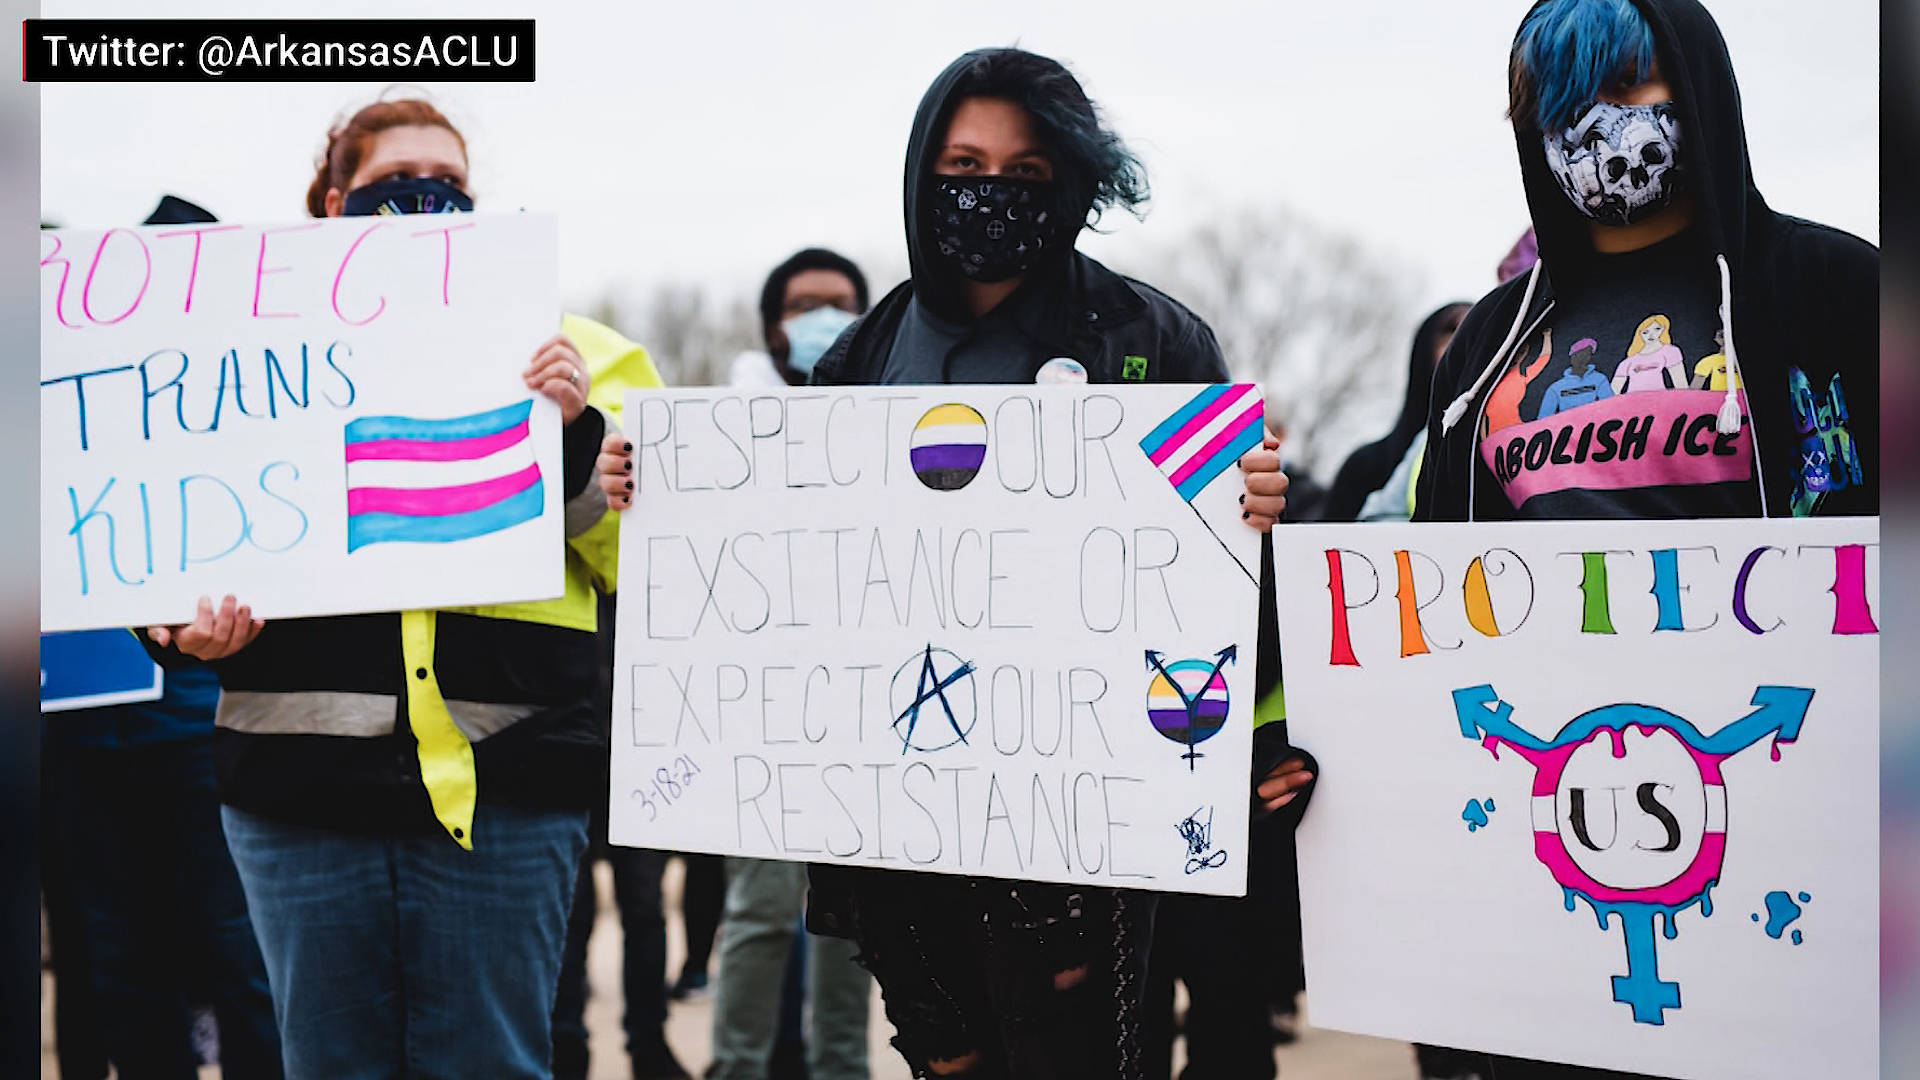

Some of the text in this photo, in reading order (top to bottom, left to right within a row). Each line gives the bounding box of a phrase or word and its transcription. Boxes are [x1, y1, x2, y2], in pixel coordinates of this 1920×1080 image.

[41, 341, 356, 451] TRANS
[639, 394, 1127, 500] RESPECT OUR
[1494, 415, 1655, 488] ABOLISH
[68, 461, 308, 596] KIDS
[646, 526, 1183, 640] EXSITANCE OR
[1324, 544, 1879, 668] PROTECT
[631, 663, 881, 748] EXPECT
[991, 664, 1114, 759] OUR
[631, 753, 701, 822] 3-18-21
[733, 754, 1156, 879] RESISTANCE
[1569, 782, 1681, 852] US
